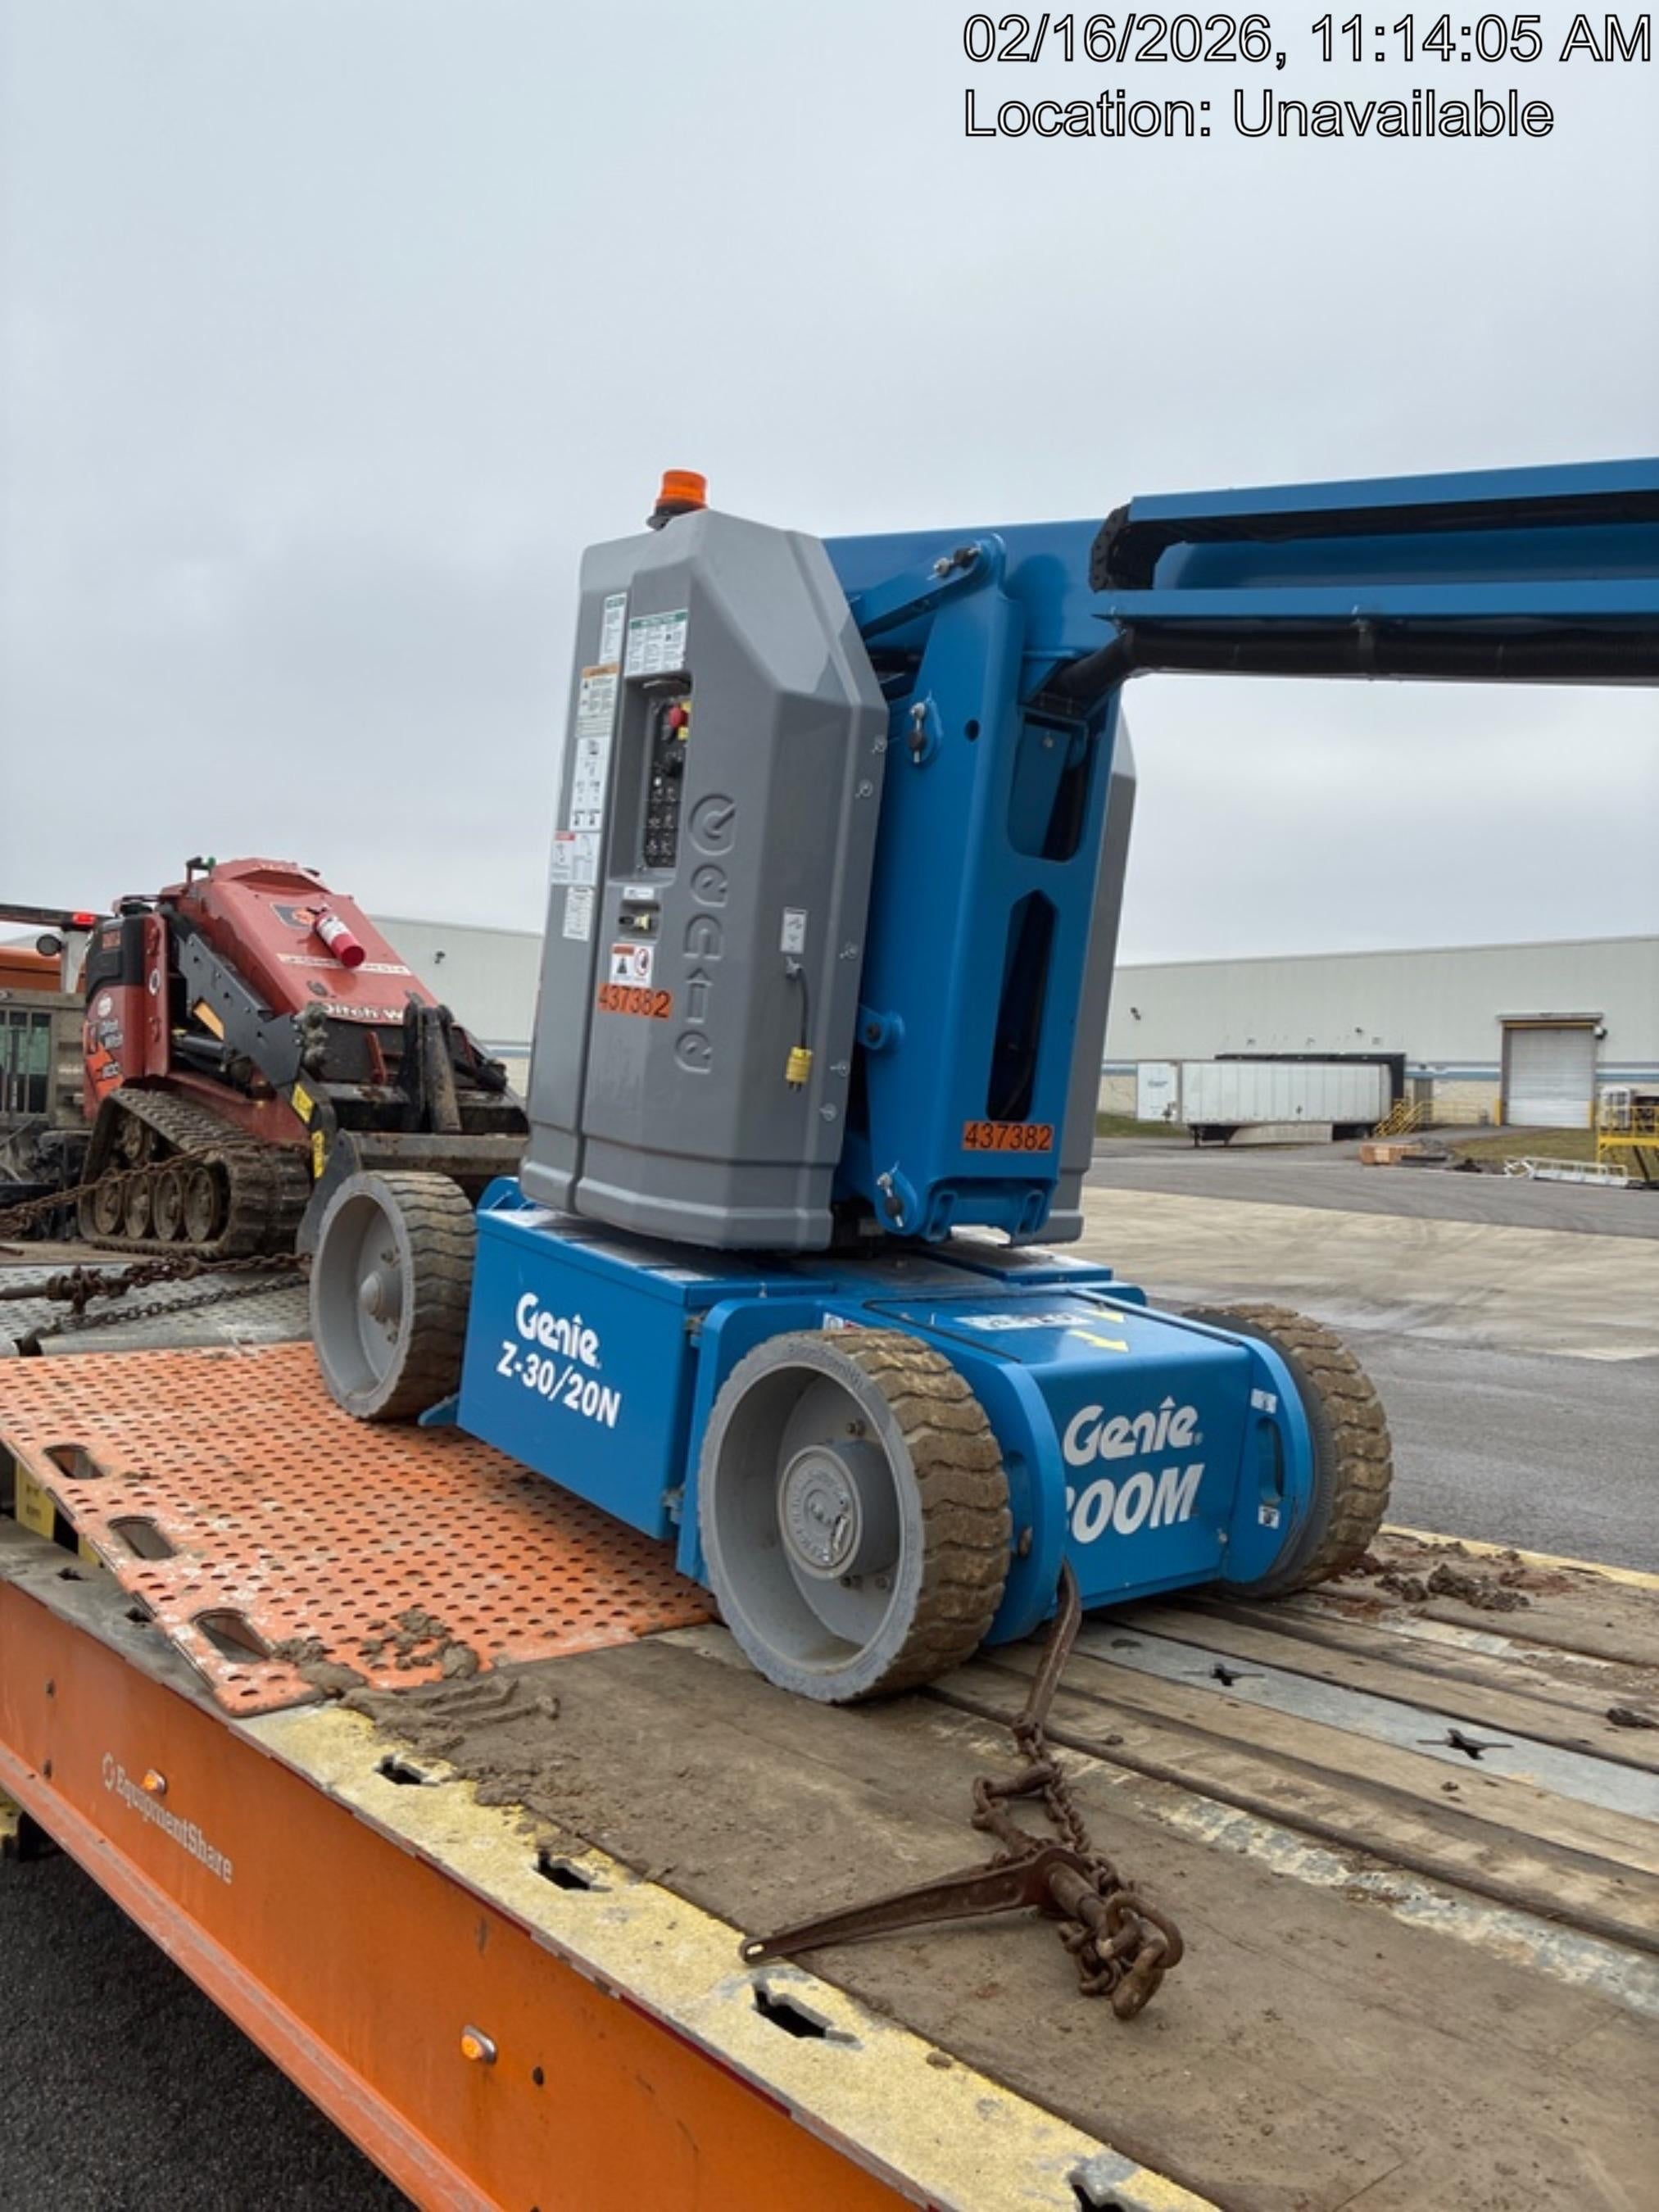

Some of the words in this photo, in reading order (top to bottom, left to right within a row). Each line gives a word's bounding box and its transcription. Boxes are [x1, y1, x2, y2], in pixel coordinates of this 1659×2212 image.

[599, 985, 671, 1018] 437382
[964, 1122, 1053, 1151] 437382
[516, 1292, 601, 1369] Genie
[496, 1340, 622, 1429] Z-30/20N
[1063, 1395, 1199, 1466] Genie
[1065, 1462, 1205, 1544] OOM
